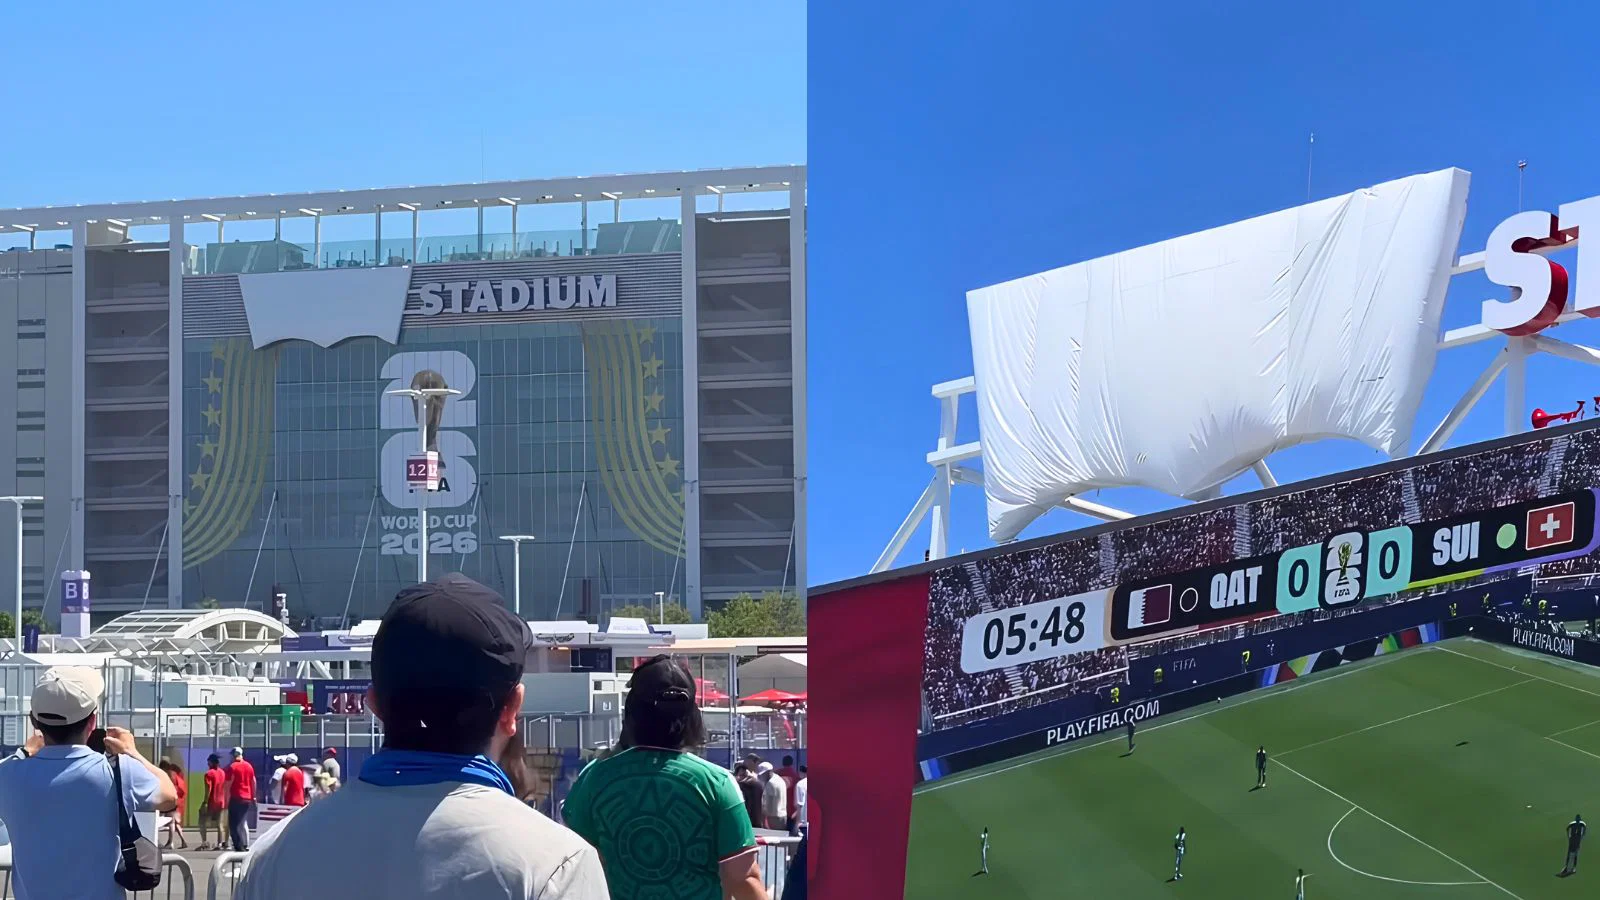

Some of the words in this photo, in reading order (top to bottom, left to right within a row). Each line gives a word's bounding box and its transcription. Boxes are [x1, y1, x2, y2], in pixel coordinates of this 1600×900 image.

[419, 274, 617, 316] STADIUM
[408, 463, 427, 477] 12
[381, 515, 441, 530] WORD
[443, 514, 477, 528] CUP
[381, 532, 477, 555] 2026
[1210, 568, 1262, 609] QAT
[1288, 558, 1309, 597] 0
[1379, 540, 1400, 580] 0
[1433, 522, 1480, 565] SUI
[65, 582, 78, 599] B
[983, 602, 1086, 660] 05:48
[1173, 658, 1197, 672] FIFA
[1047, 700, 1160, 745] PLAY.FIFA.COM
